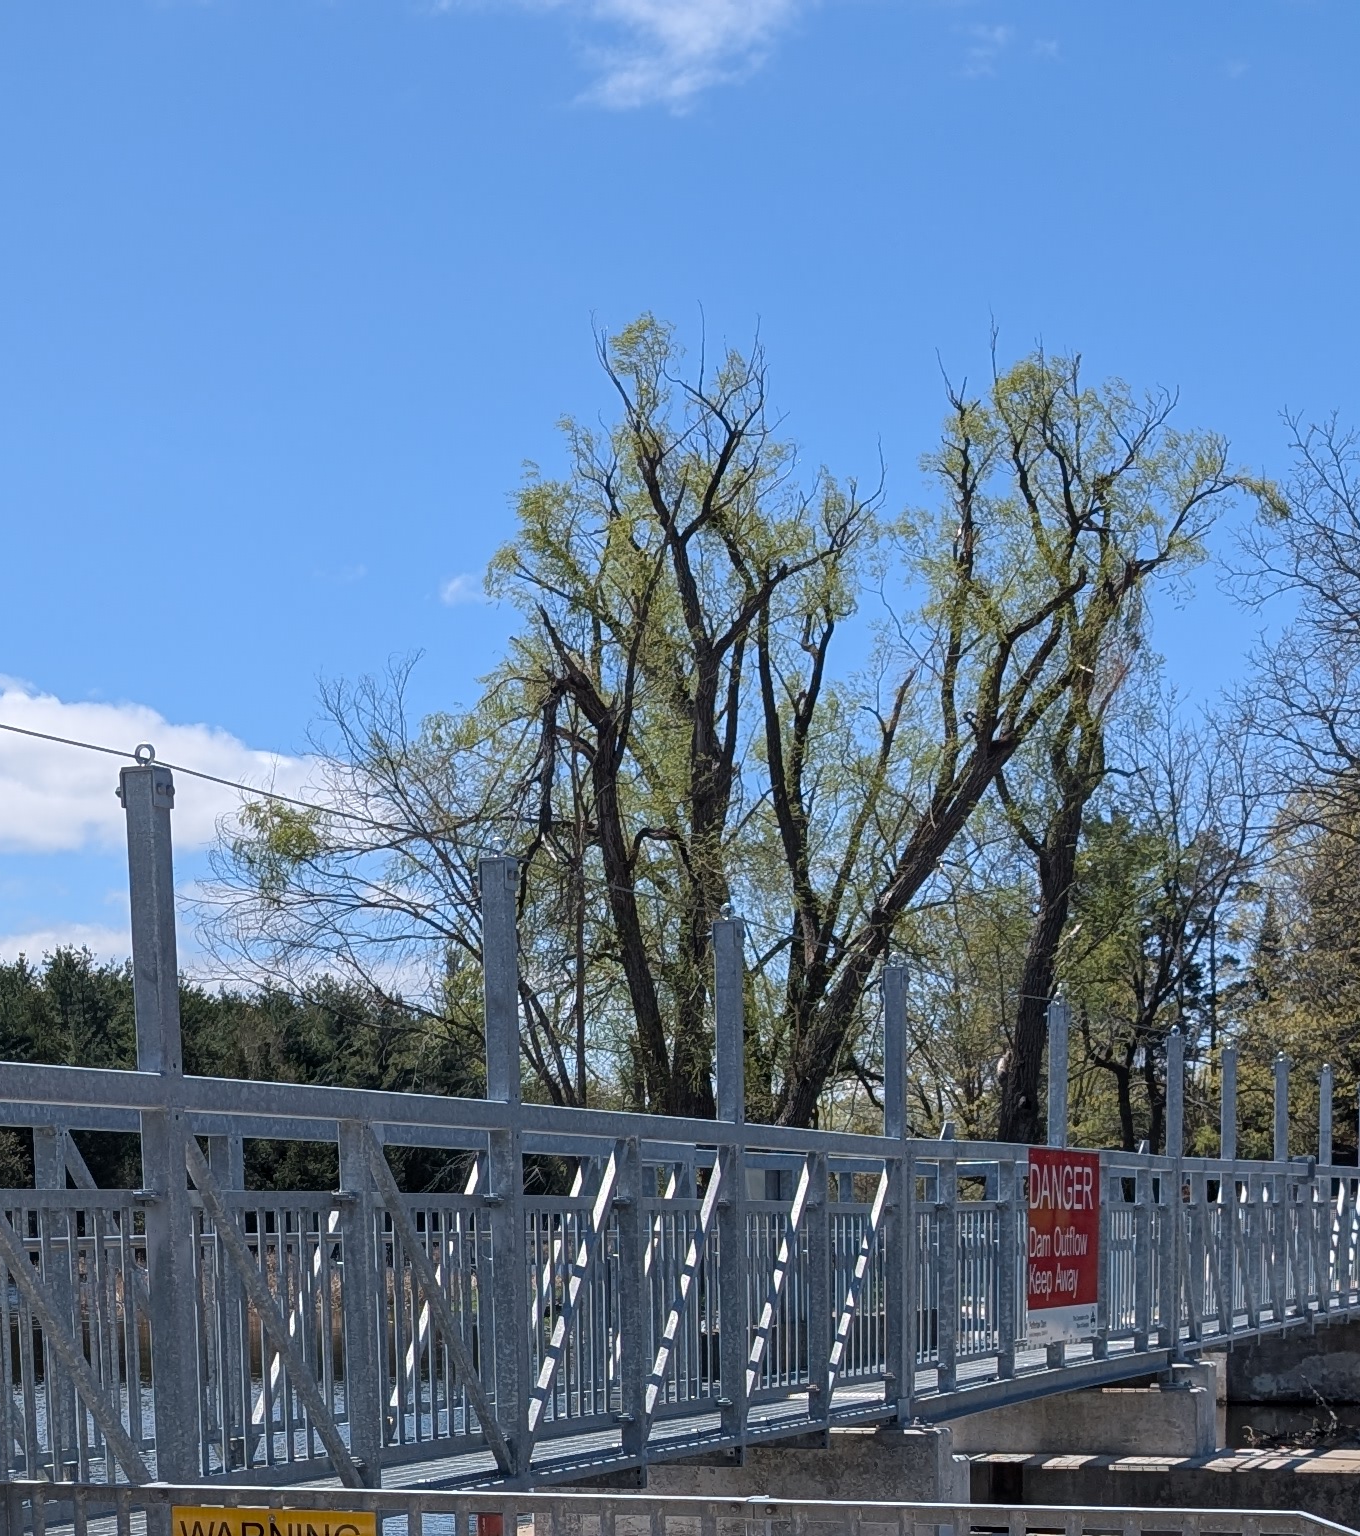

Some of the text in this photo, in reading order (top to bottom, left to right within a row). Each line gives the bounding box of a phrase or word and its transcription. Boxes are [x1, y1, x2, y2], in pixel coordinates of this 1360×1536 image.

[1029, 1163, 1093, 1211] DANGER
[1029, 1226, 1088, 1258] Dam Outflow
[1029, 1263, 1079, 1301] Keep Away
